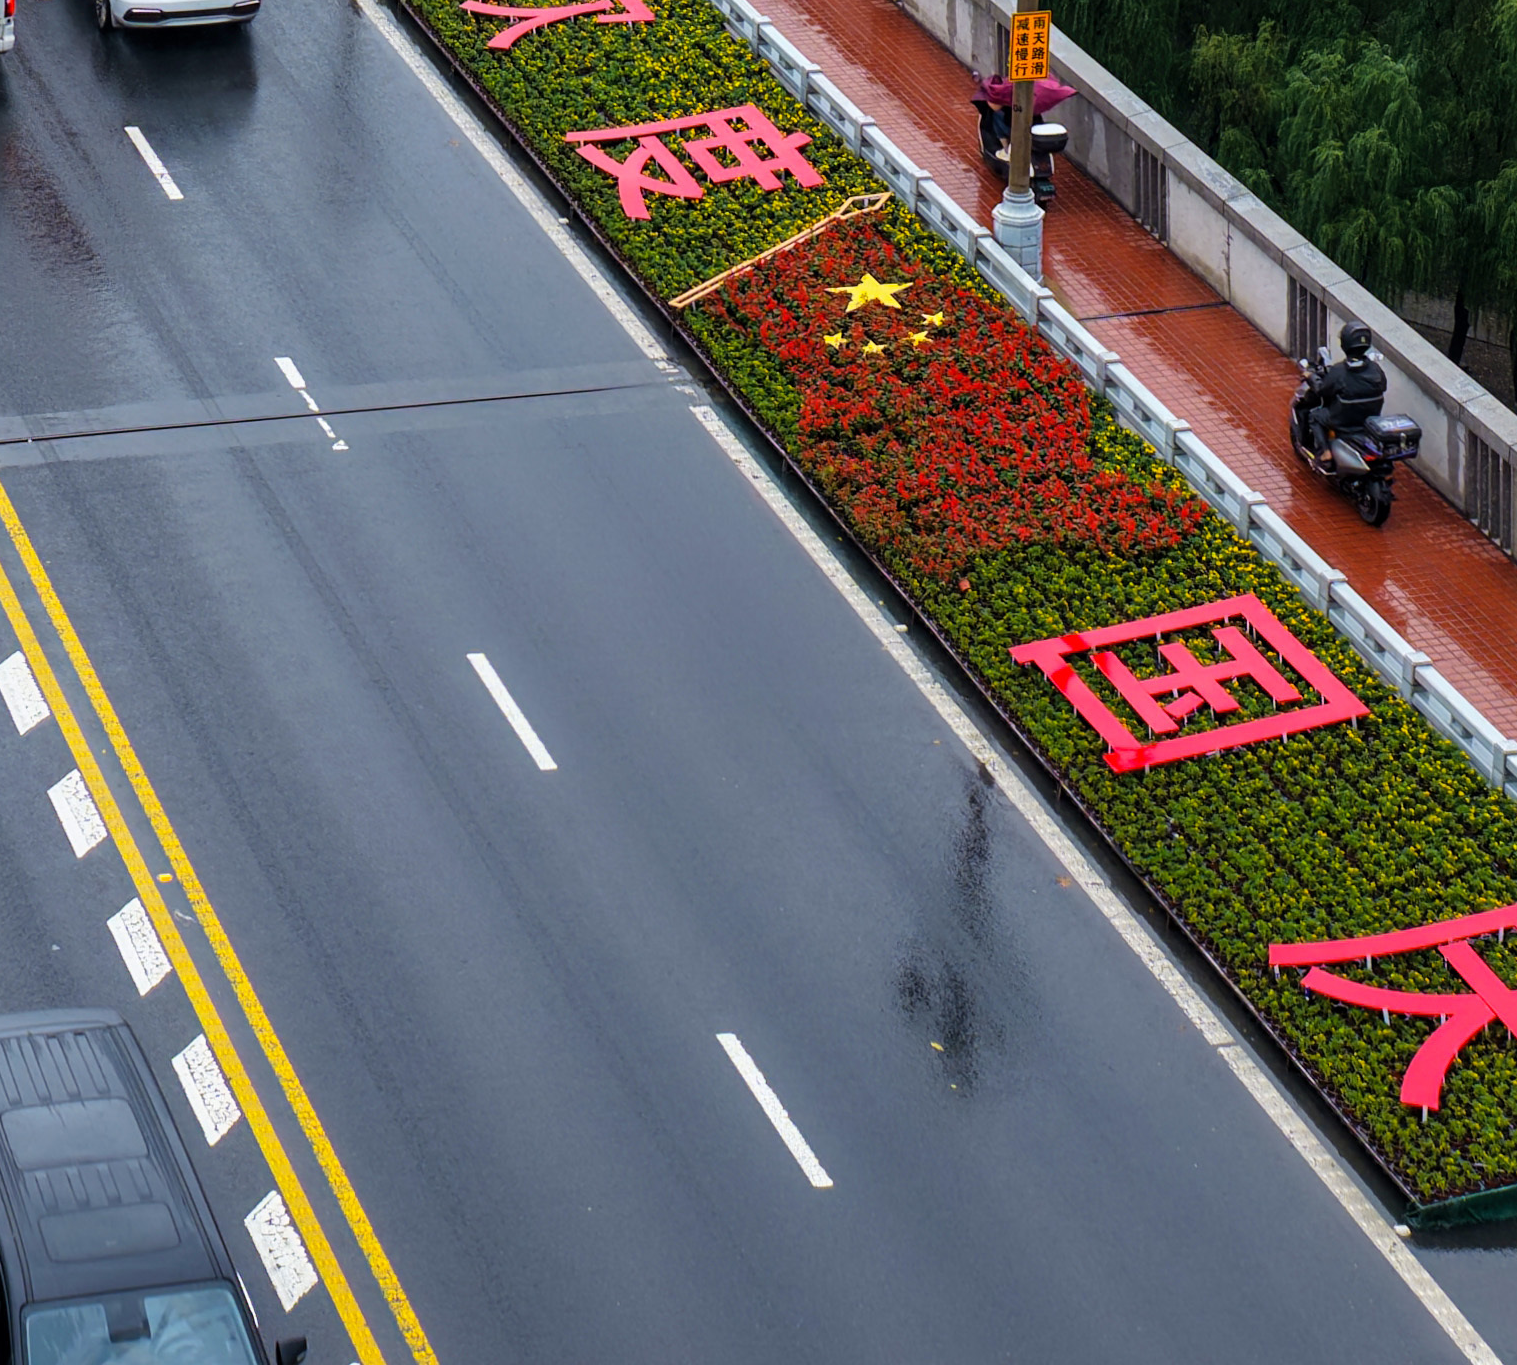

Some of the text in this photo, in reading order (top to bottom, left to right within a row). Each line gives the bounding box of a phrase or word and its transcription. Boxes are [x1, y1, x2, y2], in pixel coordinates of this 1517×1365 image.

[1014, 17, 1030, 77] 减速慢行
[1031, 16, 1046, 75] 雨天路滑
